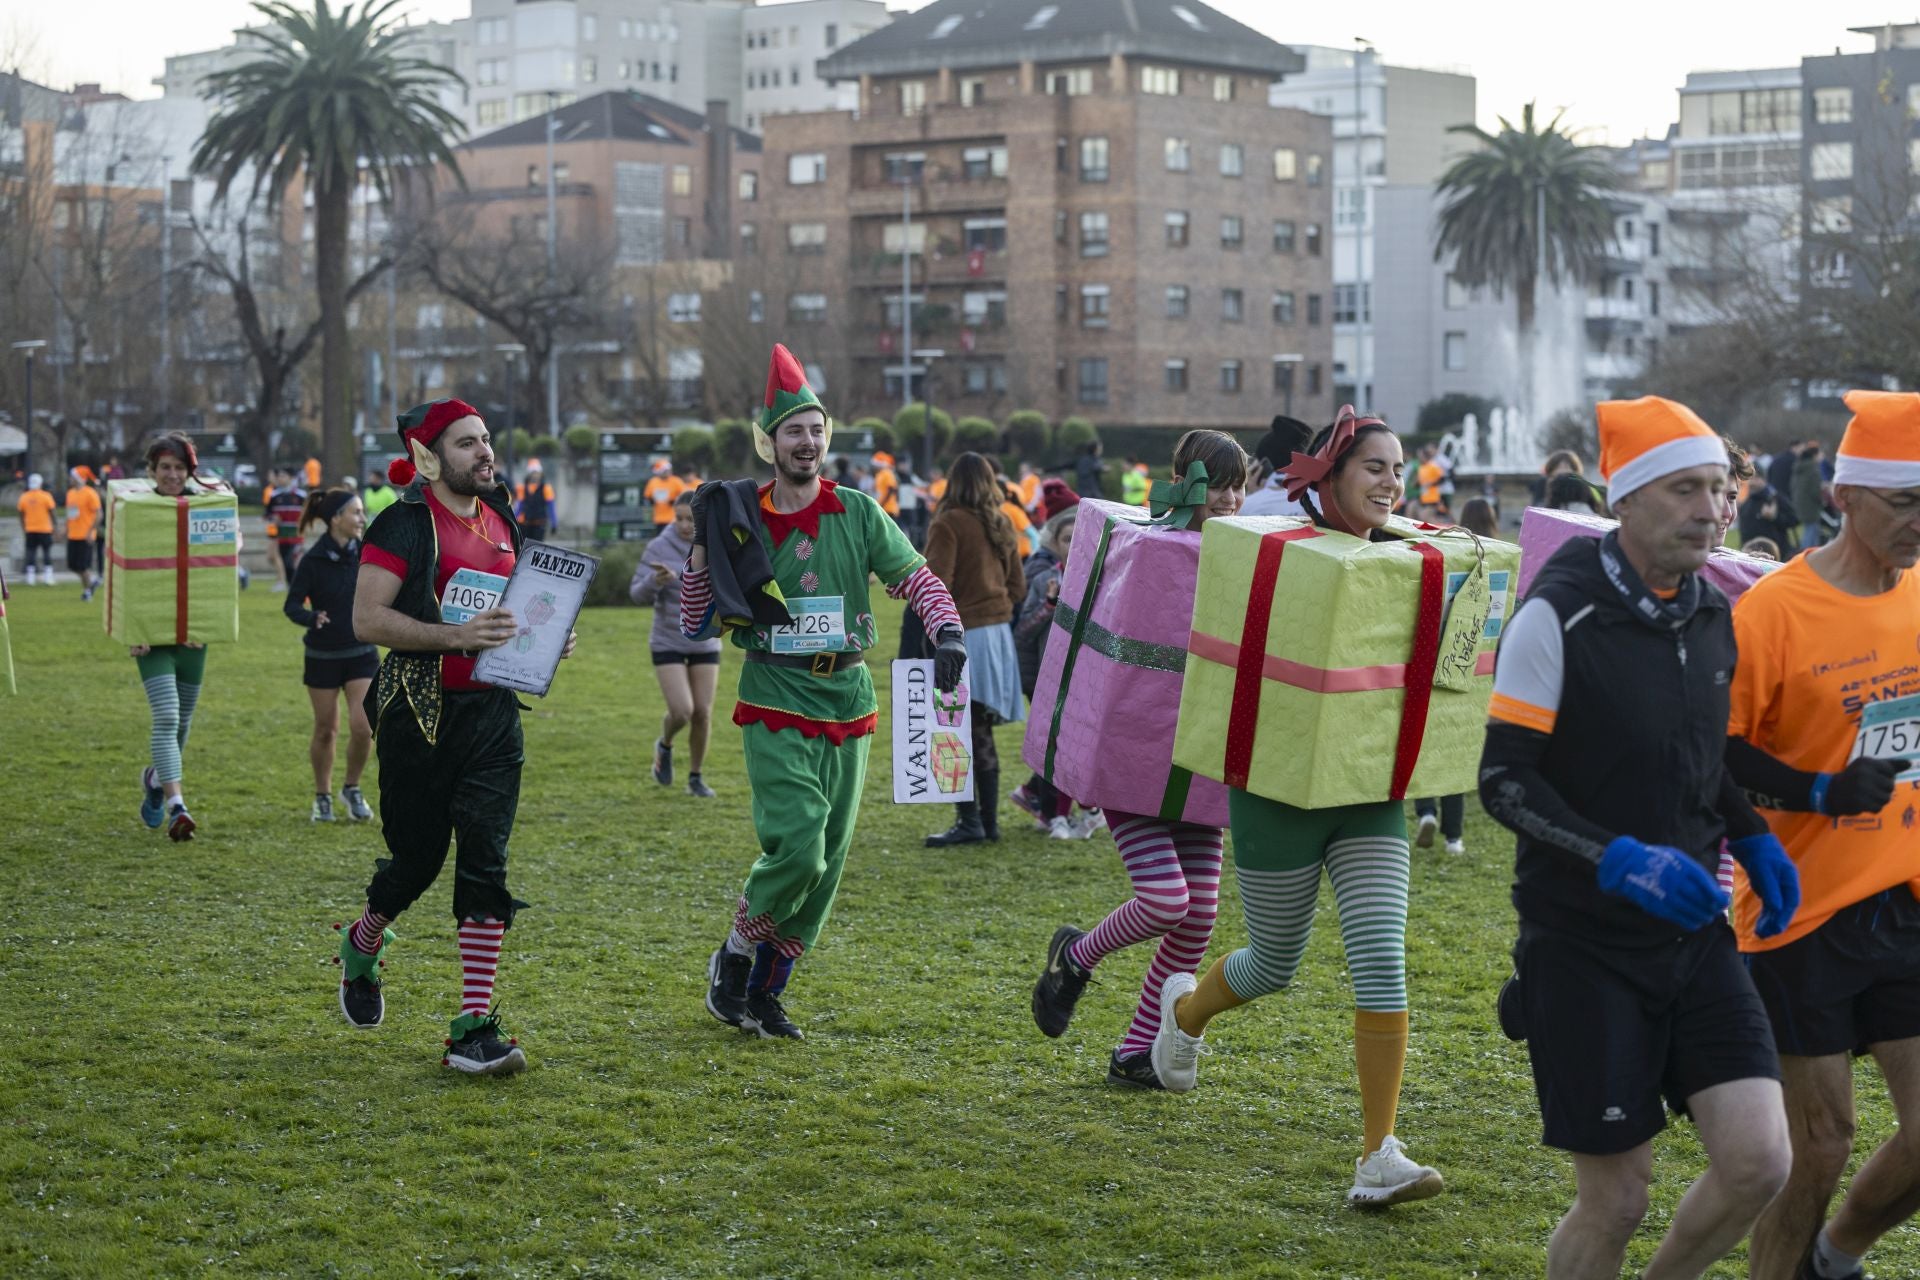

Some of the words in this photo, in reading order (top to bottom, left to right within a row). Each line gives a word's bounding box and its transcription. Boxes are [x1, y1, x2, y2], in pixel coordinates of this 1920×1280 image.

[193, 520, 228, 533] 1025
[530, 550, 586, 578] WANTED
[450, 586, 497, 610] 1067
[776, 614, 830, 634] 2126
[905, 667, 928, 798] WANTED
[1857, 720, 1920, 758] 1757
